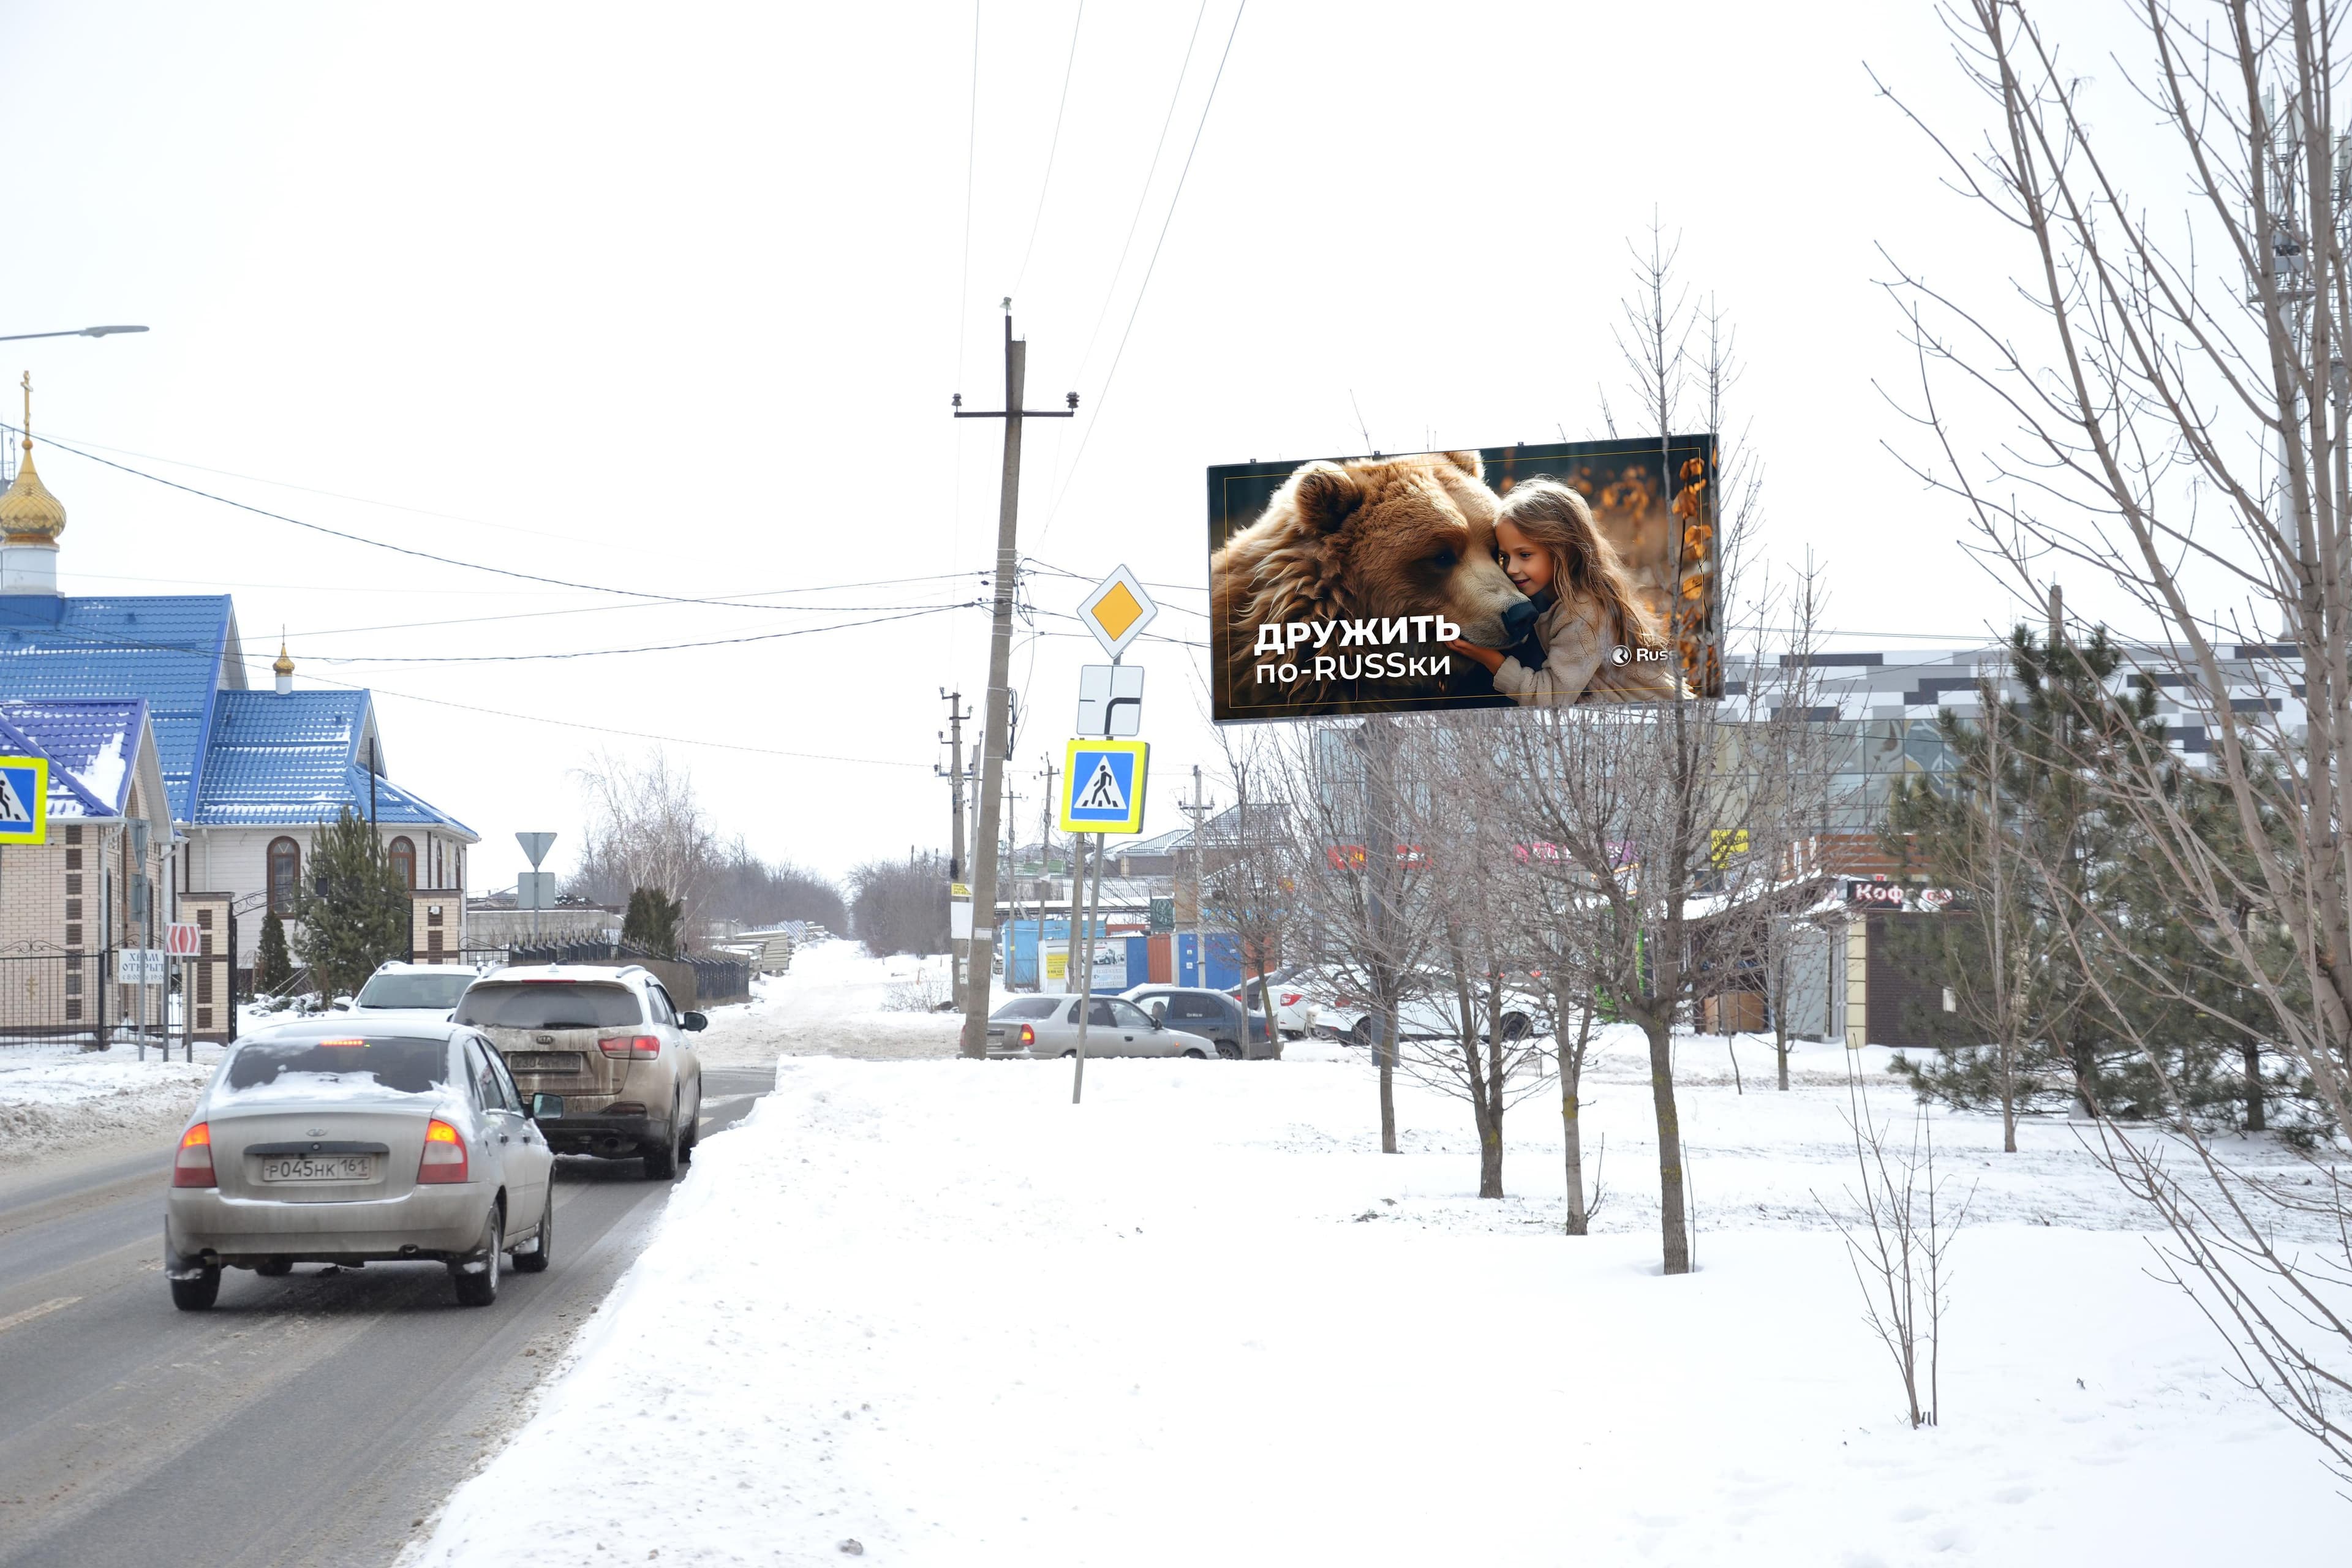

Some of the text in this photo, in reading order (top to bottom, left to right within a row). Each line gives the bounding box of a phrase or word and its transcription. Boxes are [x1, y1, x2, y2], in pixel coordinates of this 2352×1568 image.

[1254, 614, 1461, 655] ДРУЖИТЬ
[1257, 652, 1450, 684] по-RUSSки
[341, 1159, 366, 1171] 161
